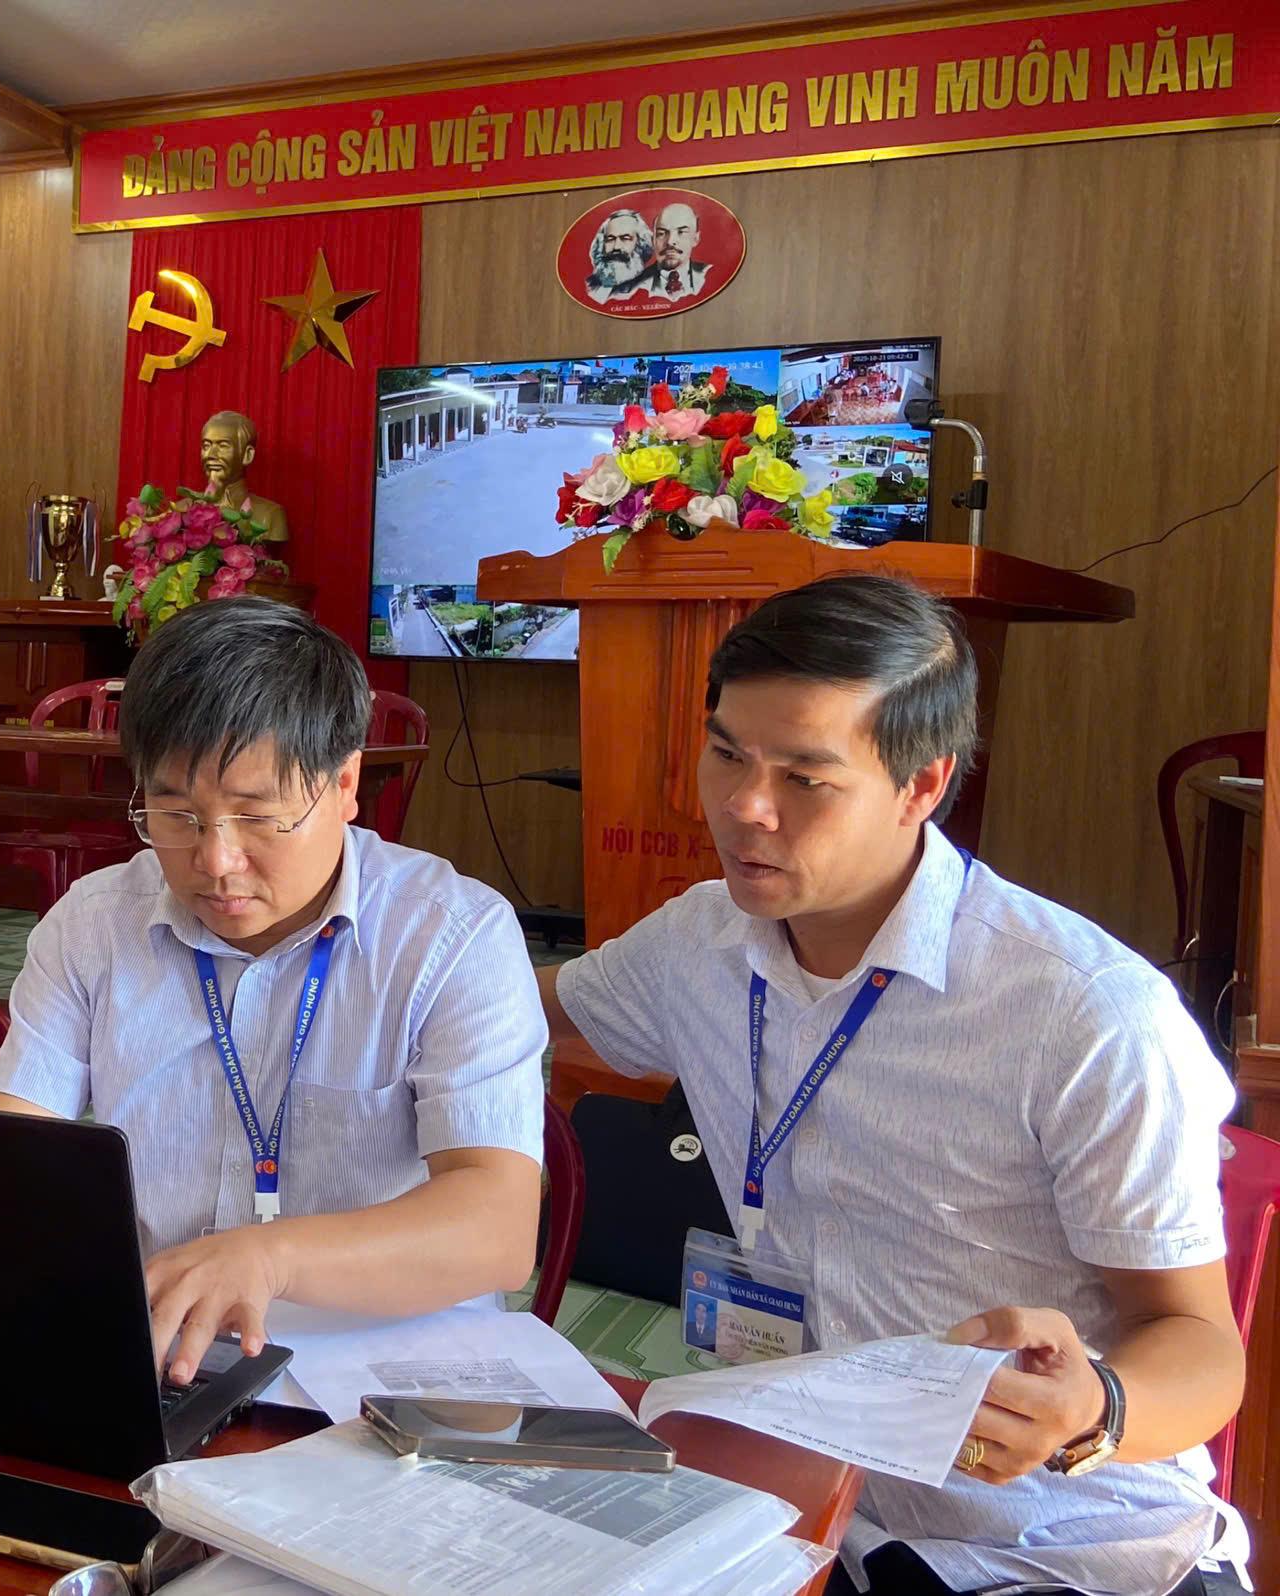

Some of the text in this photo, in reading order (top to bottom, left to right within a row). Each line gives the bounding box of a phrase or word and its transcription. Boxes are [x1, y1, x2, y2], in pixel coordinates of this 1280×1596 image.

[123, 25, 1234, 198] ĐẢNG CỘNG SẢN VIỆT NAM QUANG VINH MUÔN NĂM
[602, 823, 634, 860] HỘI
[641, 830, 679, 858] CCB
[212, 1009, 226, 1034] GIAO
[299, 1009, 312, 1036] GIAO
[809, 1060, 829, 1086] GIAO
